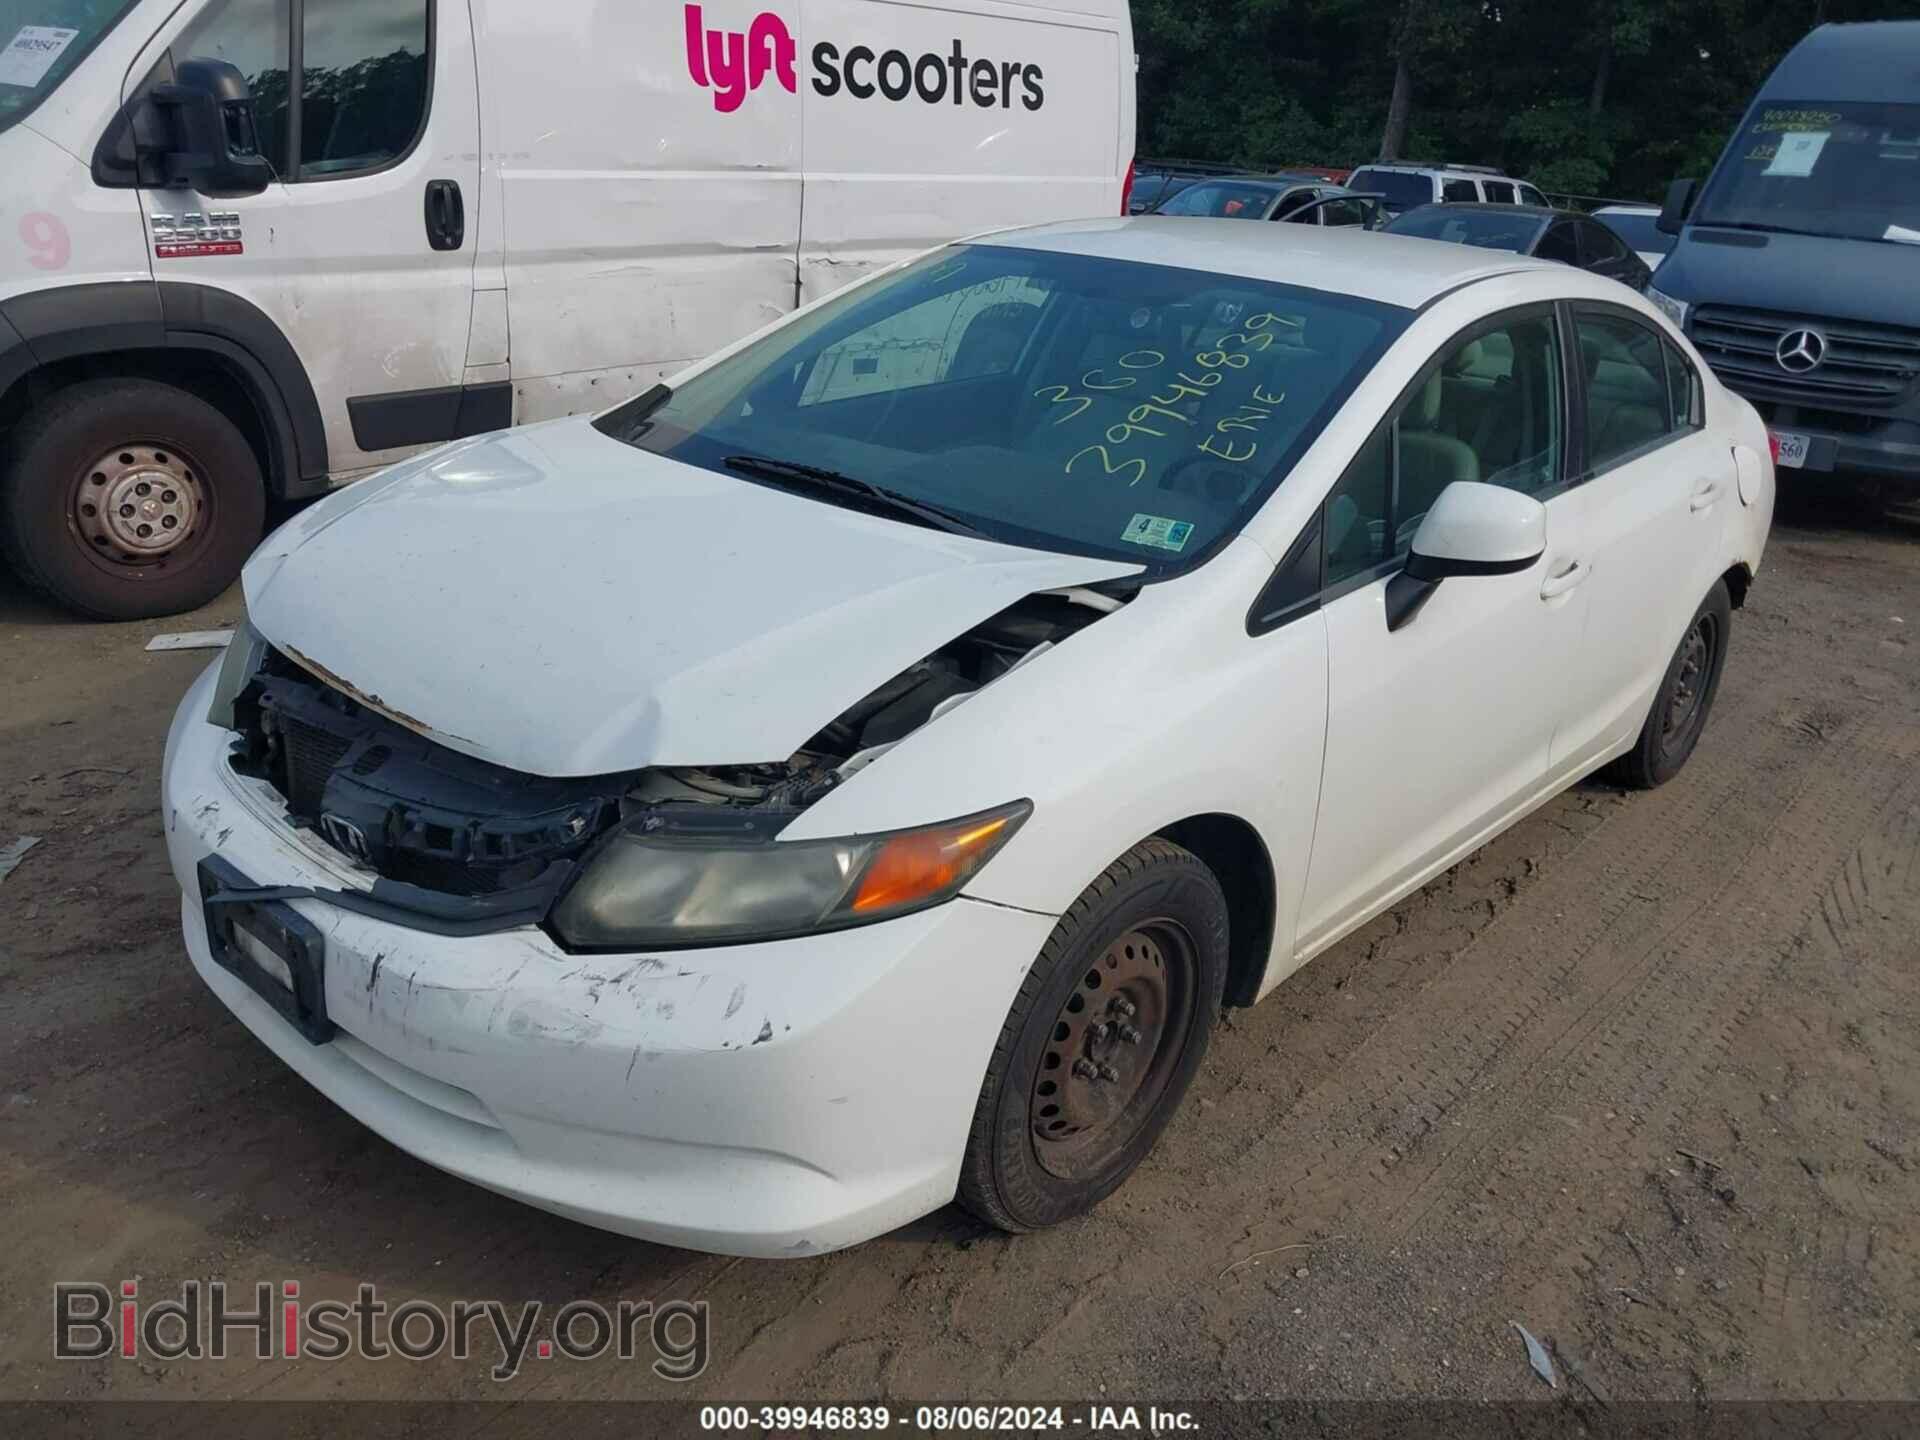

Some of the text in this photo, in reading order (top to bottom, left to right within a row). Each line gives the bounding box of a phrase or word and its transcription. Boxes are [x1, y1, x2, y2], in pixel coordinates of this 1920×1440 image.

[685, 3, 1044, 113] lyft scooters
[18, 211, 71, 271] 9
[153, 227, 242, 243] 2500
[1064, 312, 1299, 487] 39946839
